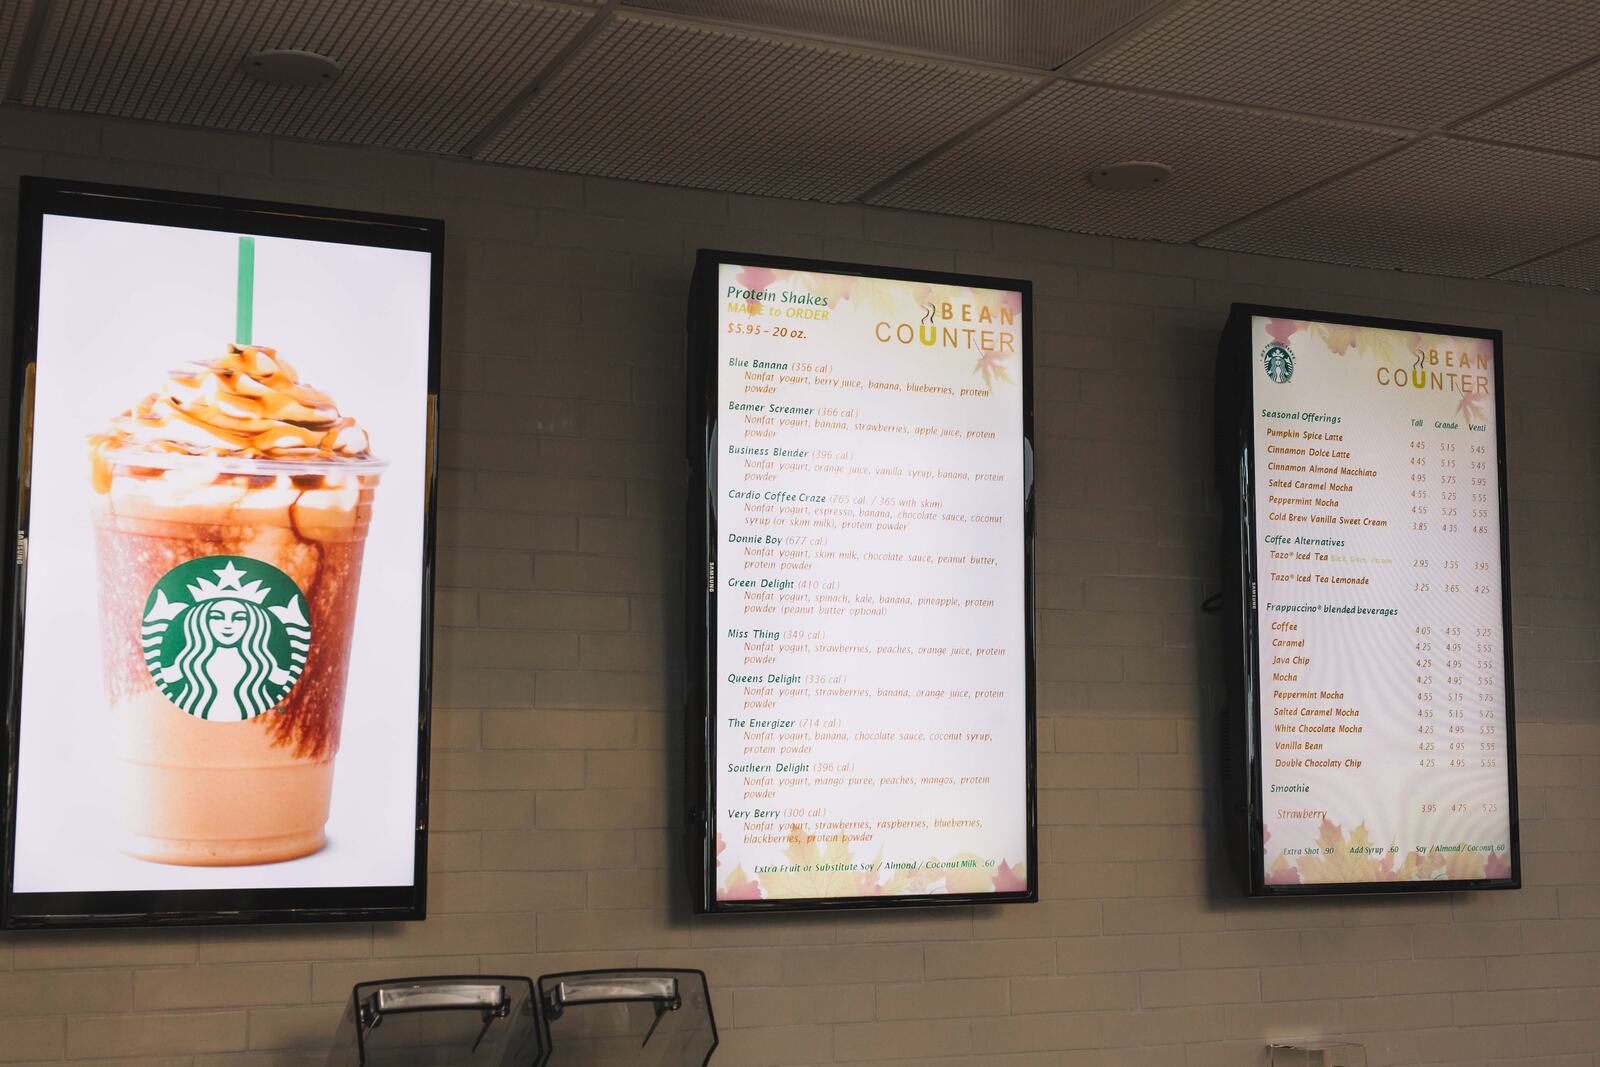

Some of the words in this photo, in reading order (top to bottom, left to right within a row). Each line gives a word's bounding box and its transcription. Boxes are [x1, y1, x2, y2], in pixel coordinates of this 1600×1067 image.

[727, 286, 775, 301] Protein
[780, 291, 827, 306] Shakes
[942, 302, 1013, 325] BEAN
[772, 326, 787, 337] 20
[790, 330, 806, 338] oz.
[876, 322, 1014, 352] COUNTER
[729, 357, 748, 367] Blue
[752, 359, 787, 370] Banana
[1429, 349, 1488, 370] BEAN
[744, 371, 774, 381] Nonfat
[814, 376, 839, 387] berry
[960, 386, 991, 397] protein
[1377, 367, 1489, 394] COUNTER
[744, 385, 776, 393] powder
[728, 401, 765, 411] Beamer
[769, 404, 814, 415] Screamer
[1261, 409, 1299, 420] Seasonal
[1301, 412, 1341, 424] Offerings
[1411, 418, 1423, 426] Tall
[1434, 421, 1458, 429] Grande
[1468, 423, 1485, 431] Venti
[1266, 428, 1299, 438] Pumpkin
[1302, 431, 1322, 440] Spice
[1324, 432, 1343, 441] Latte
[728, 444, 768, 455] Business
[773, 448, 808, 457] Blender
[1267, 445, 1305, 455] Cinnamon
[1308, 448, 1330, 457] Dolce
[1331, 450, 1350, 458] Latte
[1268, 462, 1306, 472] Cinnamon
[1308, 464, 1338, 474] Almond
[1340, 466, 1377, 477] Macchiato
[1268, 479, 1292, 488] Salted
[1294, 480, 1326, 490] Caramel
[1329, 483, 1353, 492] Mocha
[728, 489, 760, 499] Cardio
[764, 491, 796, 502] Coffee
[799, 494, 826, 502] Craze
[1268, 495, 1312, 505] Peppermint
[1315, 498, 1338, 507] Mocha
[1268, 512, 1286, 520] Cold
[1288, 513, 1308, 522] Brew
[1310, 514, 1336, 523] Vanilla
[1339, 516, 1360, 525] Sweet
[1363, 517, 1387, 526] Cream
[728, 533, 762, 543] Donnie
[765, 535, 782, 546] Boy
[1264, 535, 1291, 545] Coffee
[1294, 536, 1344, 547] Alternatives
[744, 546, 774, 557] Nonfat
[815, 550, 835, 558] skim
[863, 552, 903, 561] chocolate
[937, 556, 965, 564] peanut
[1296, 552, 1310, 560] Iced
[1314, 552, 1328, 560] Tea
[744, 561, 776, 569] protein
[780, 561, 811, 570] powder
[728, 578, 756, 587] Green
[760, 578, 794, 590] Delight
[1296, 574, 1311, 582] Iced
[1315, 574, 1328, 583] Tea
[1331, 576, 1369, 584] Lemonade
[744, 590, 773, 601] Nonfat
[744, 603, 776, 614] powder
[781, 605, 813, 614] (peanut
[818, 605, 844, 614] butter
[849, 607, 886, 616] optional)
[1323, 604, 1356, 614] blended
[1357, 606, 1397, 616] beverages
[1271, 621, 1297, 631] Coffee
[728, 629, 748, 638] Miss
[753, 630, 780, 640] Thing
[1272, 638, 1304, 647] Caramel
[1272, 656, 1290, 664] Java
[1292, 655, 1310, 666] Chip
[727, 673, 763, 684] Queens
[767, 673, 800, 685] Delight
[1272, 672, 1297, 681] Mocha
[1273, 690, 1317, 700] Peppermint
[1320, 690, 1344, 699] Mocha
[1274, 707, 1298, 715] Salted
[1300, 708, 1332, 716] Caramel
[1335, 708, 1359, 716] Mocha
[728, 718, 746, 727] The
[750, 719, 795, 729] Energizer
[1274, 724, 1295, 732] White
[1298, 724, 1335, 733] Chocolate
[1338, 724, 1362, 733] Mocha
[1275, 741, 1302, 749] Vanilla
[1304, 742, 1322, 750] Bean
[727, 763, 771, 772] Southern
[776, 762, 809, 774] Delight
[1275, 758, 1302, 767] Double
[1304, 758, 1342, 768] Chocolaty
[1344, 758, 1361, 768] Chip
[1270, 783, 1309, 792] Smoothie
[728, 810, 750, 819] Very
[754, 809, 780, 819] Berry
[1277, 809, 1327, 819] Strawberry
[754, 865, 777, 873] Extra
[780, 864, 800, 872] Fruit
[815, 862, 857, 871] Substitute
[860, 864, 875, 872] Soy
[884, 860, 916, 869] Almond
[925, 860, 959, 868] Coconut
